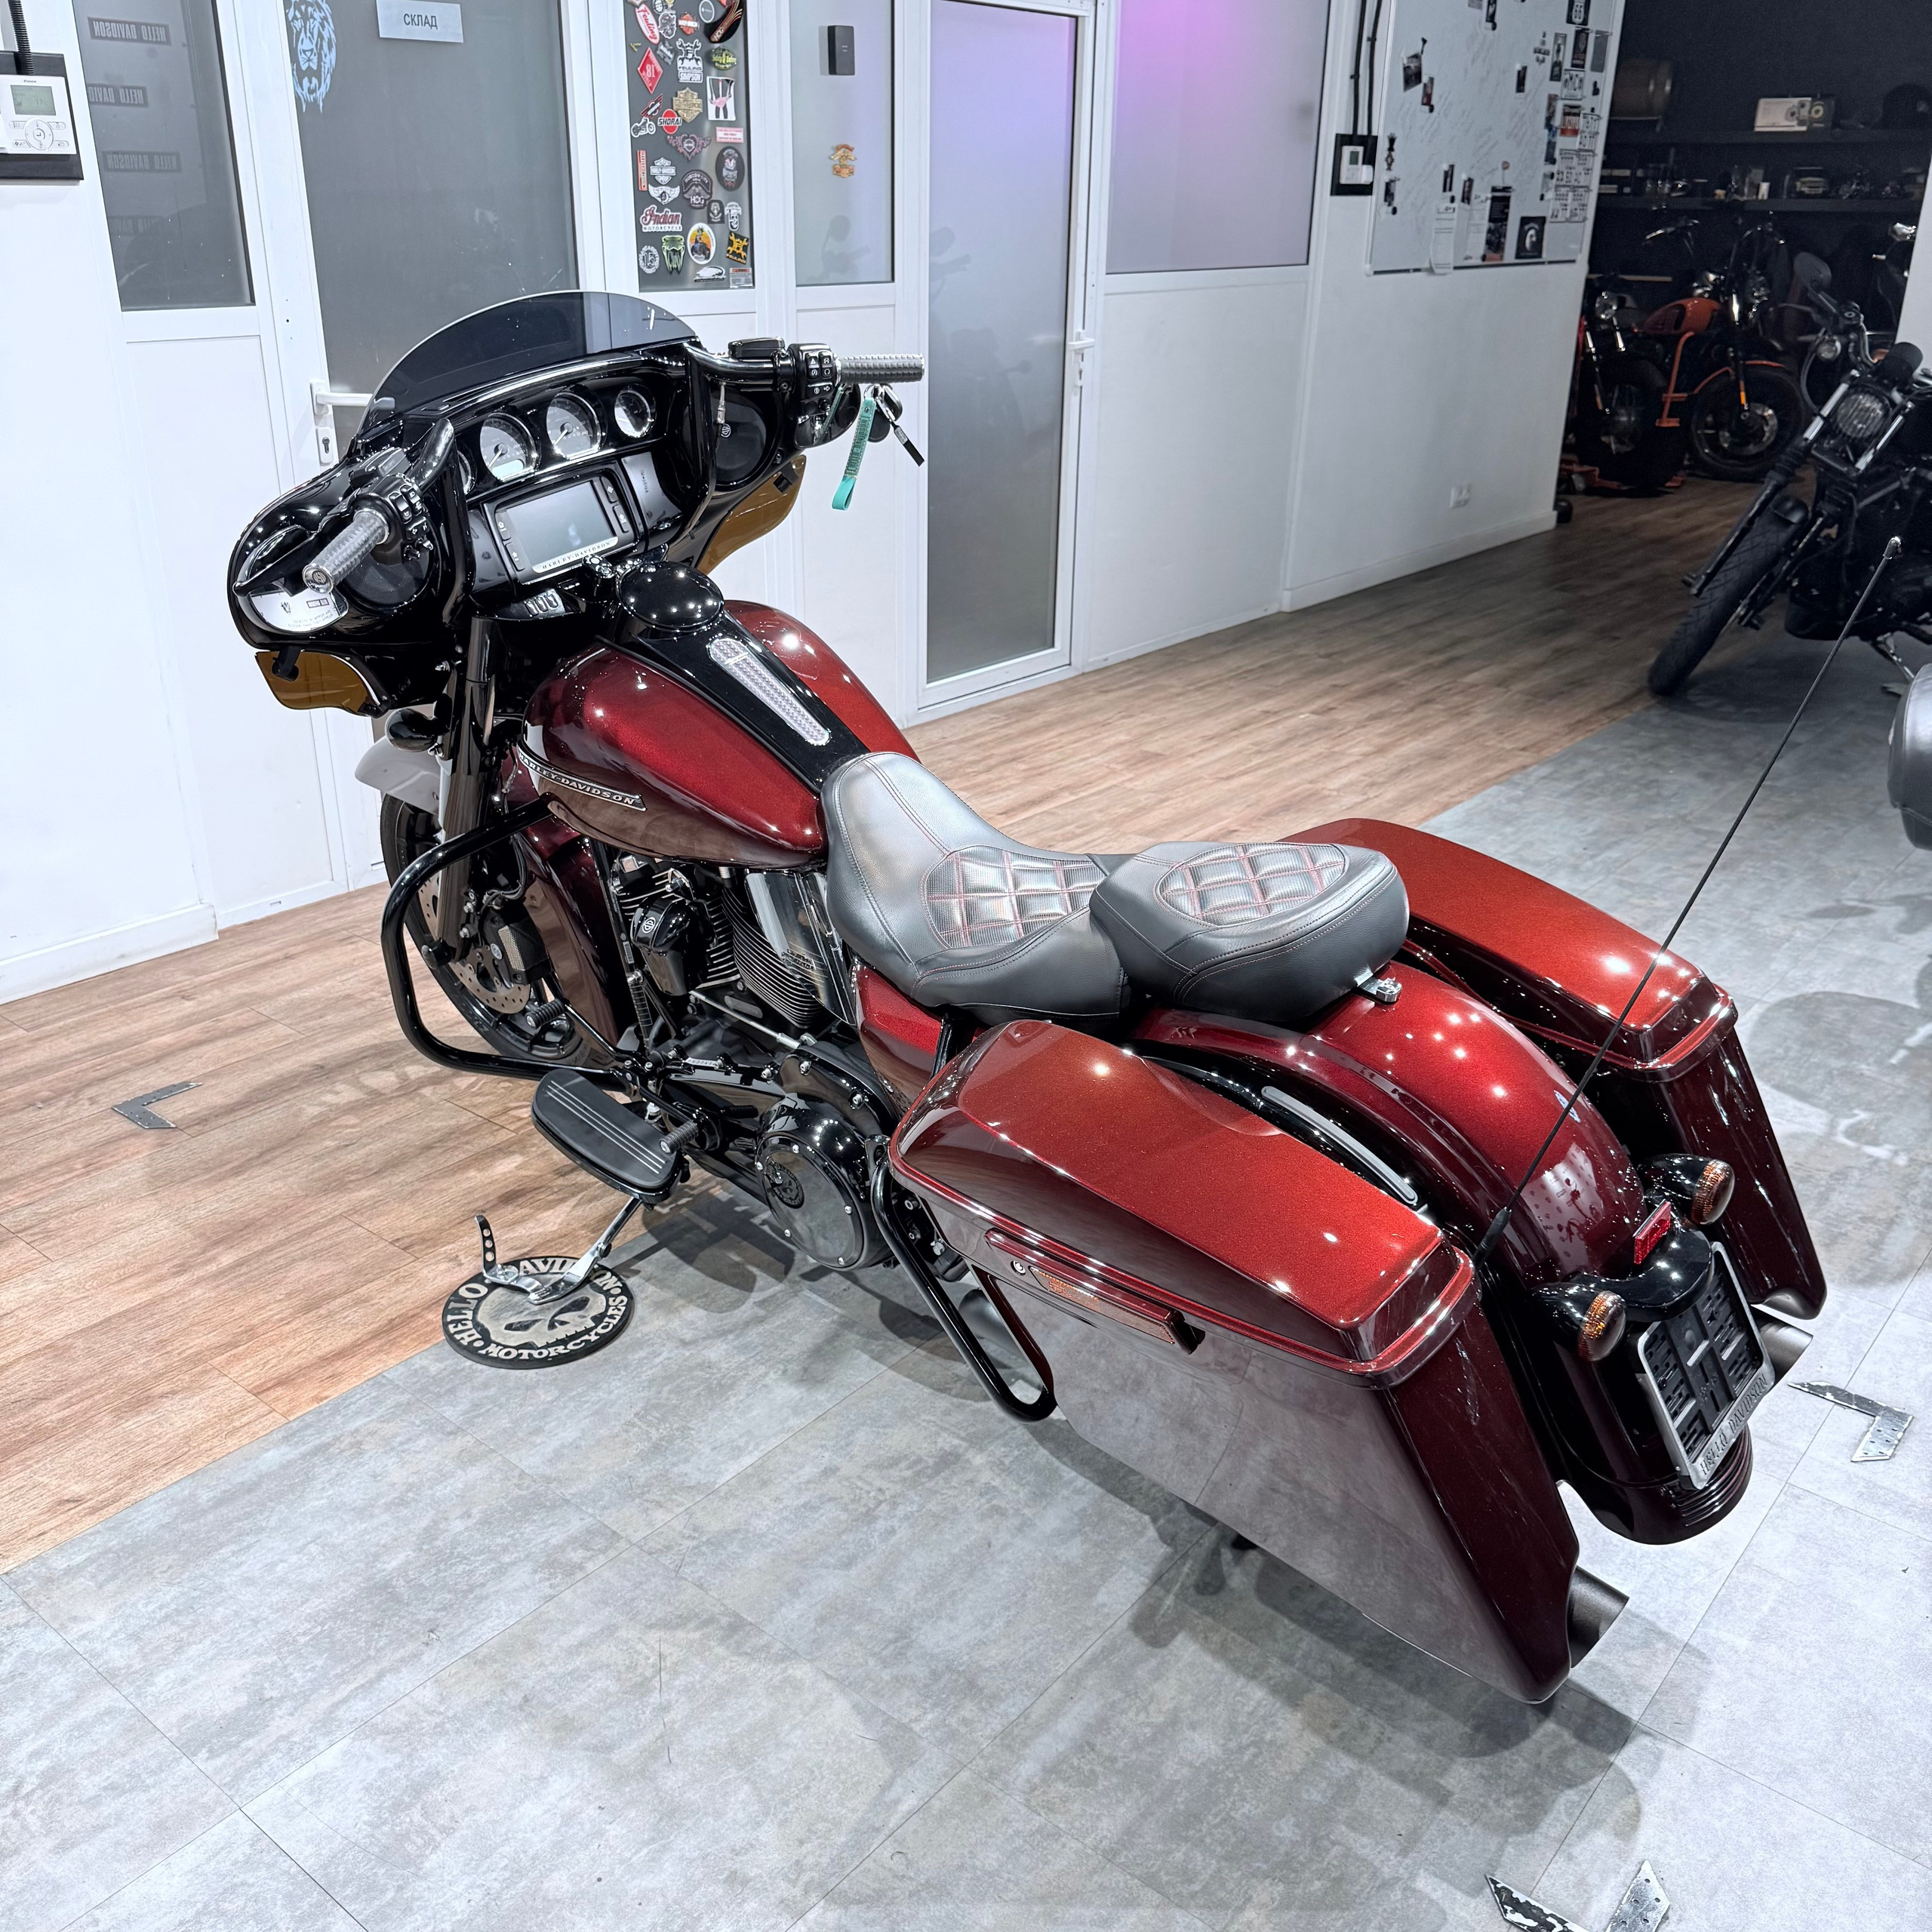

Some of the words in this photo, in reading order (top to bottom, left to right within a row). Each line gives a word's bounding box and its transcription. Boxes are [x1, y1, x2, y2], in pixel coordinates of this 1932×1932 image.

[404, 14, 438, 29] СКЛАД
[645, 64, 655, 77] 81
[641, 206, 680, 226] Indian
[543, 542, 611, 569] HARLEY-DAVIDSON
[518, 751, 634, 805] HARLEY-DAVIDSON
[447, 1283, 488, 1346] HELLO
[479, 1295, 628, 1360] MOTORCYCLES
[1700, 1432, 1727, 1475] HELLO
[1728, 1374, 1767, 1433] DAVIDSON
